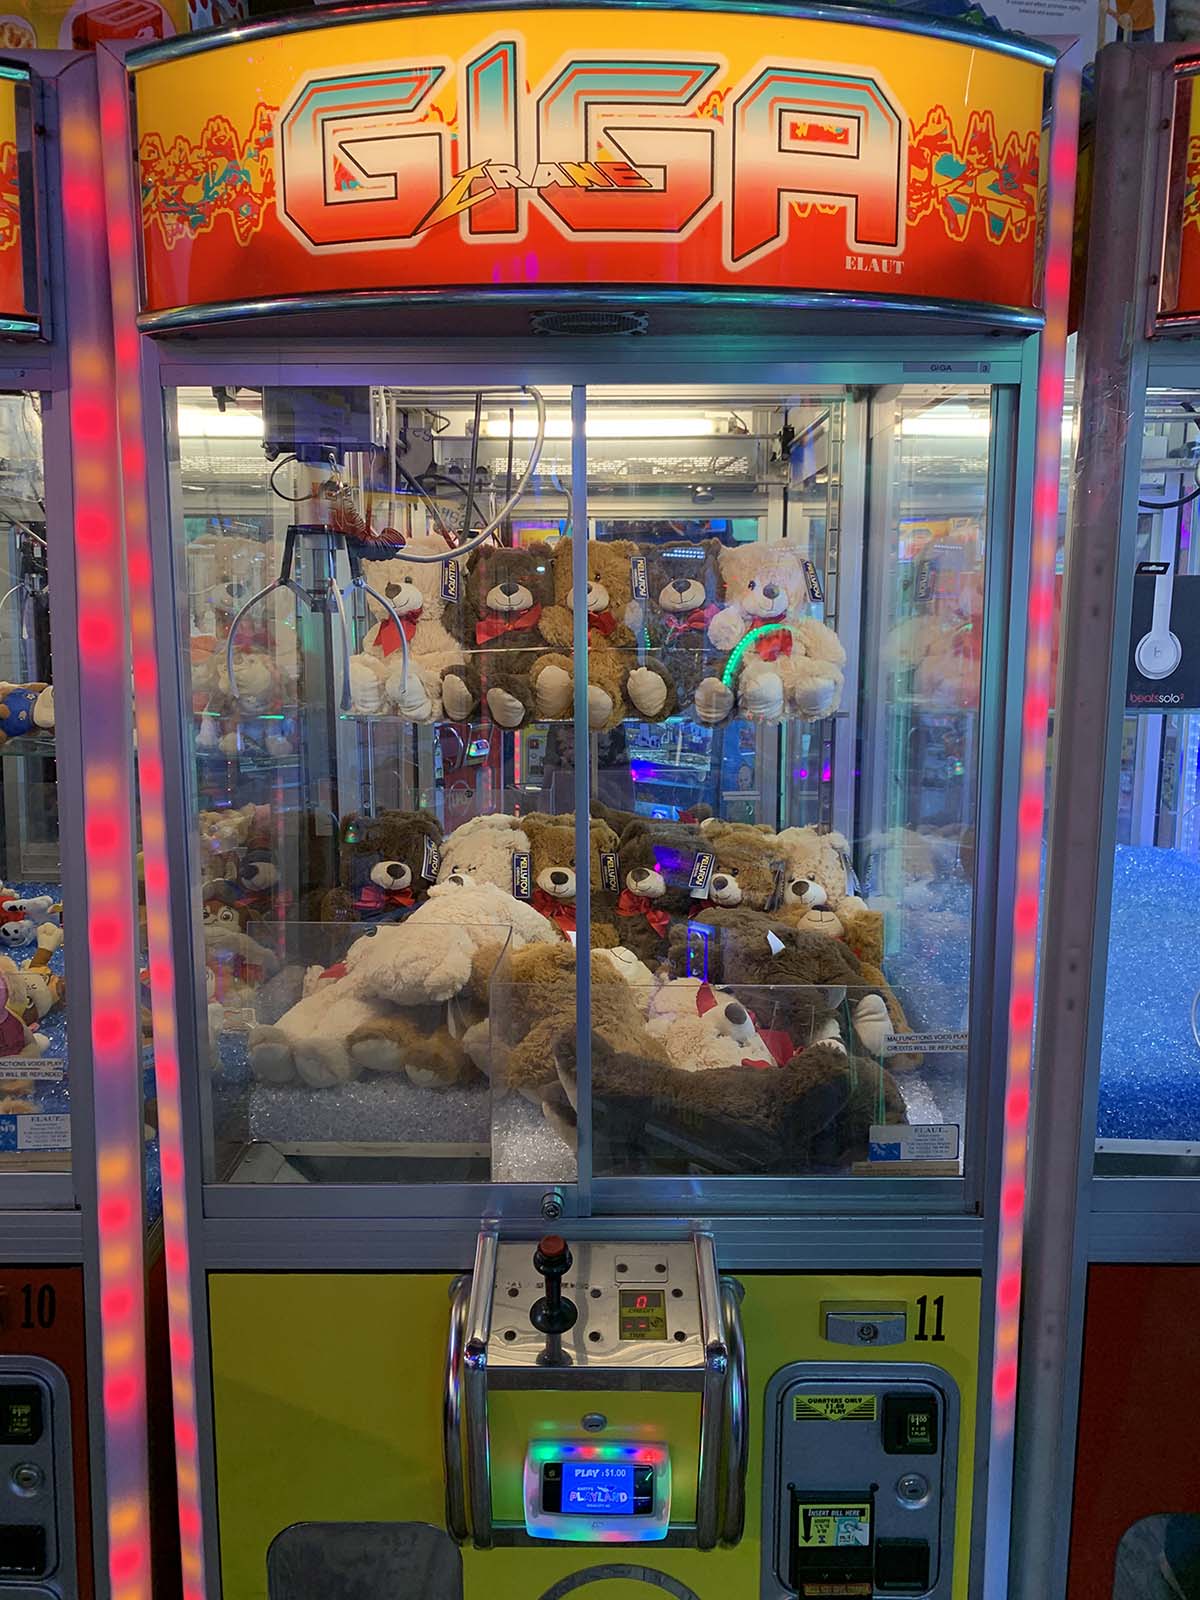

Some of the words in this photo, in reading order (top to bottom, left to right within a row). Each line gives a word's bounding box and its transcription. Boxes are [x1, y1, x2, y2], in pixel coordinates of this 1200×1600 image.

[279, 38, 904, 266] GIGA
[845, 255, 905, 275] ELAUT
[520, 856, 529, 895] KELLYTOY
[21, 1283, 56, 1328] 10
[636, 1295, 648, 1309] 0
[915, 1295, 945, 1341] 11
[575, 1469, 600, 1477] PLAY
[569, 1491, 628, 1503] PLAYLAND
